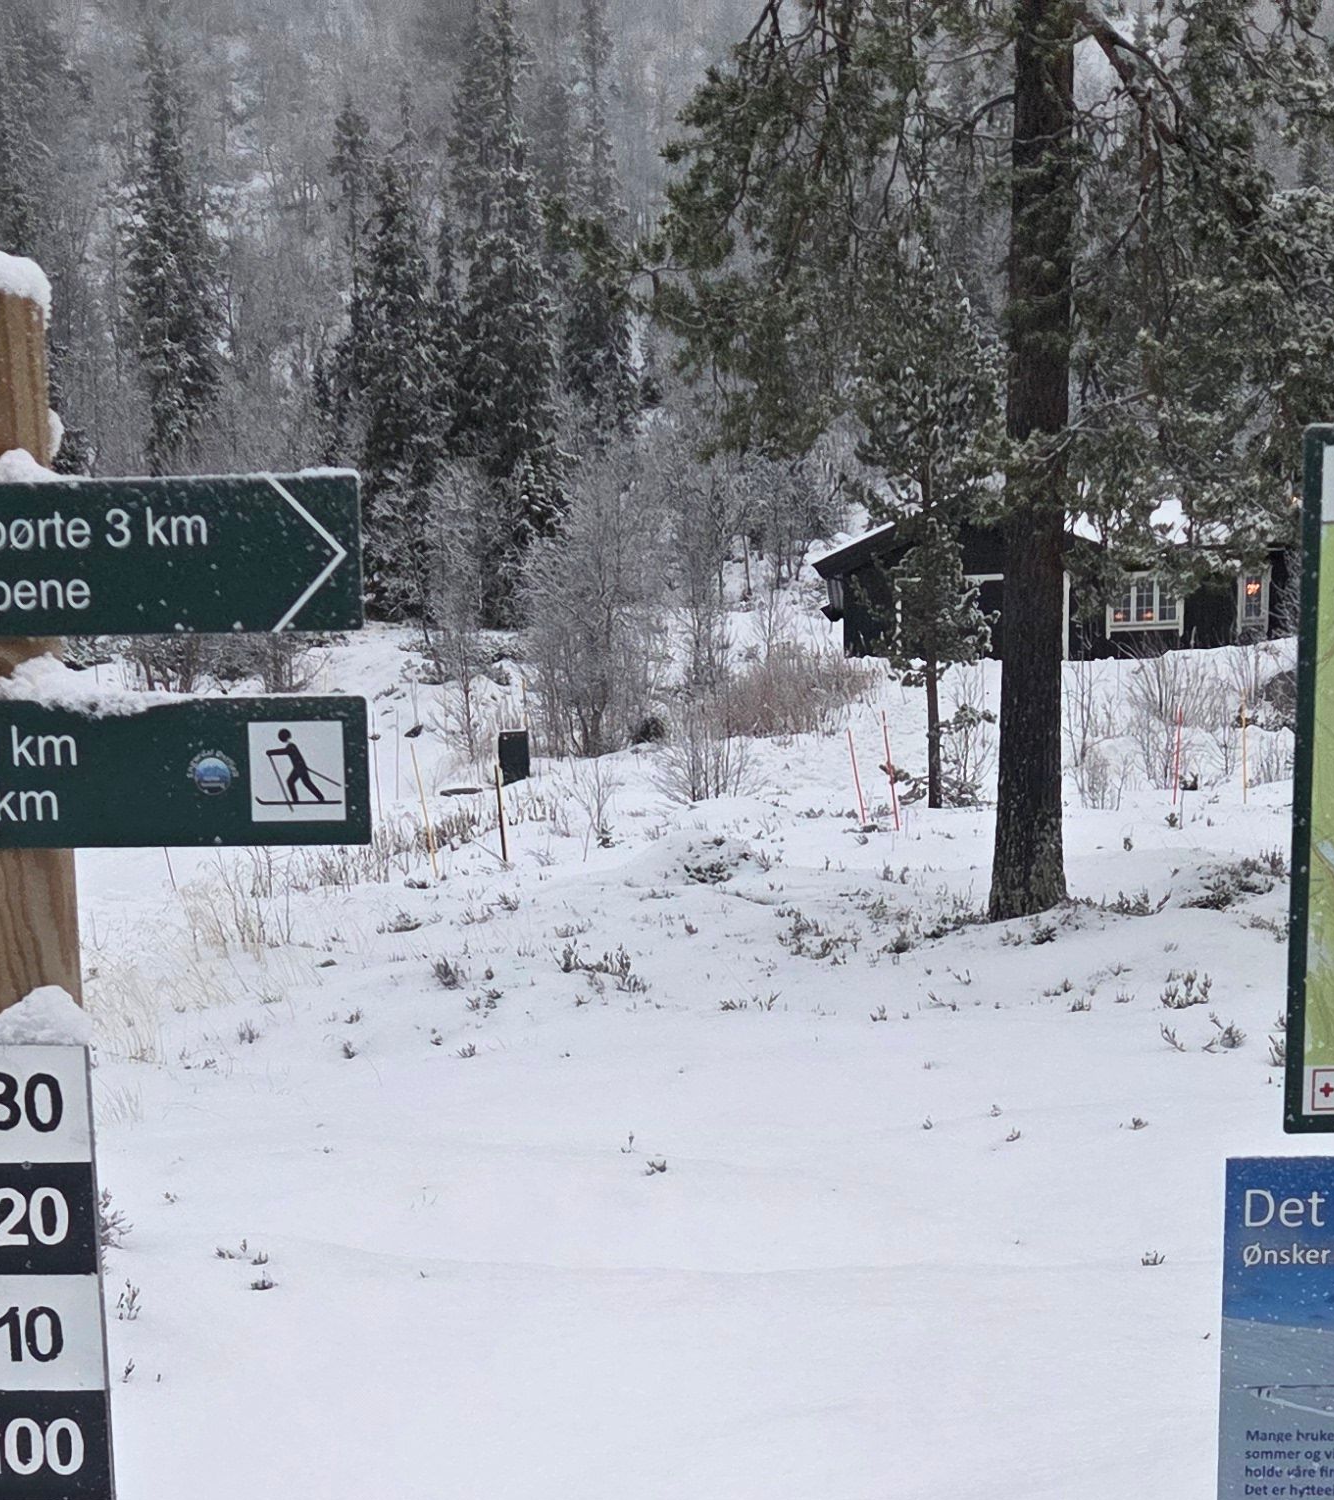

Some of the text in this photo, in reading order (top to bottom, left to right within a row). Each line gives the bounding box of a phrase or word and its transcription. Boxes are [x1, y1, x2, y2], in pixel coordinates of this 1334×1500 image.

[106, 508, 132, 547] 3
[146, 507, 208, 546] km
[12, 725, 78, 766] km
[1244, 1189, 1325, 1227] Det
[1243, 1242, 1330, 1267] Ønsker
[1246, 1430, 1292, 1443] Mange
[1245, 1450, 1301, 1460] sommer
[1304, 1450, 1321, 1462] og
[1245, 1465, 1283, 1478] holde
[1245, 1484, 1268, 1496] Det
[1272, 1485, 1286, 1496] er
